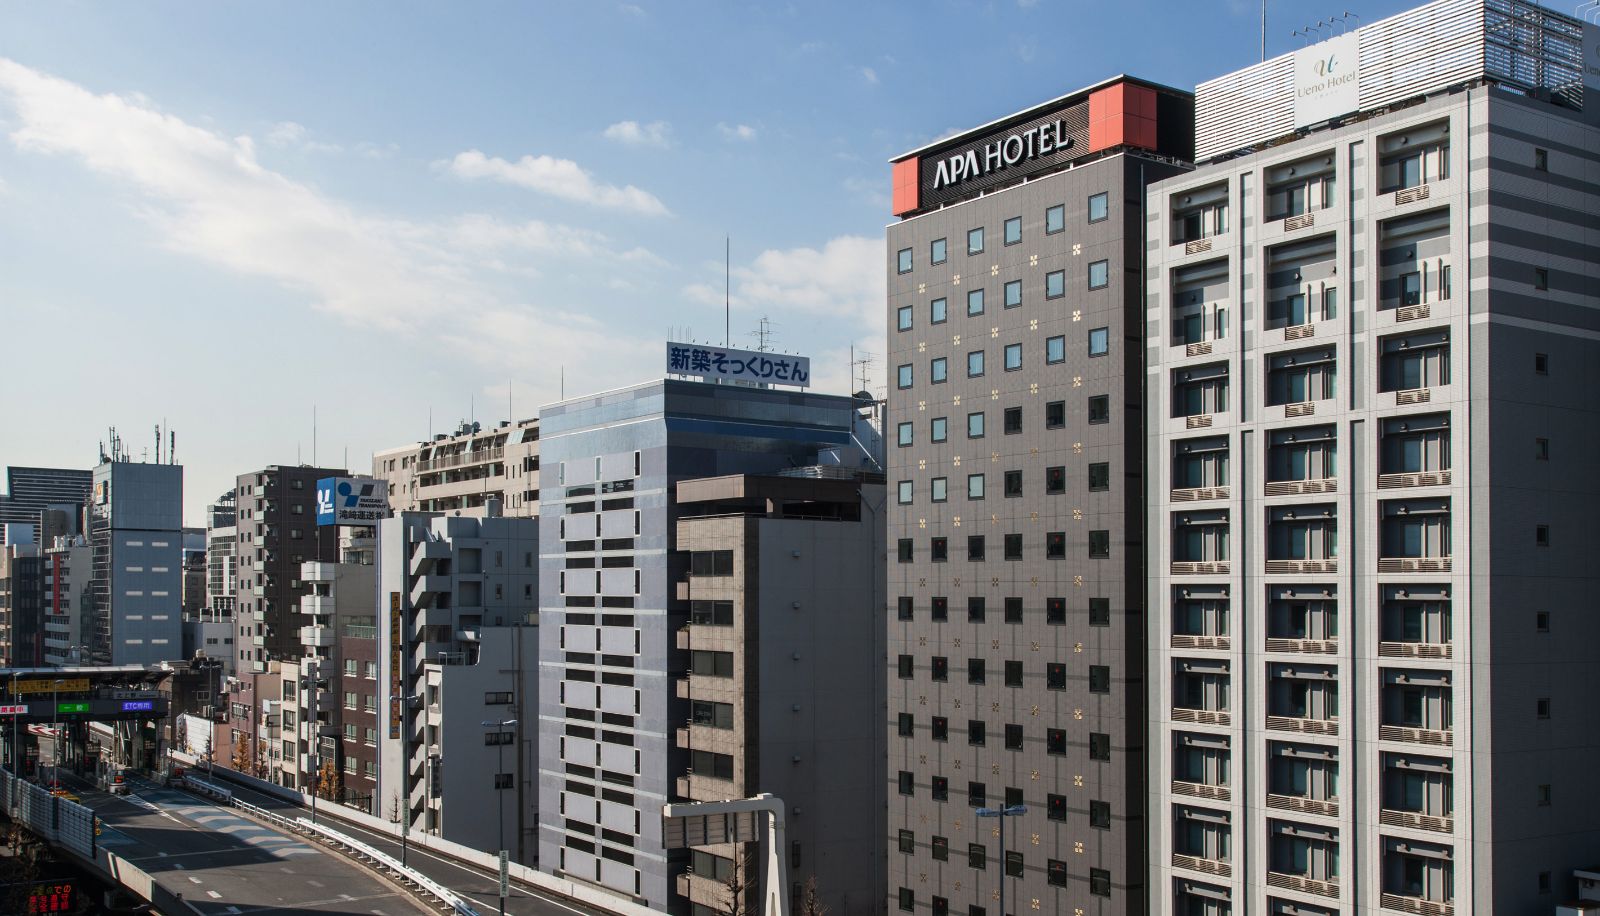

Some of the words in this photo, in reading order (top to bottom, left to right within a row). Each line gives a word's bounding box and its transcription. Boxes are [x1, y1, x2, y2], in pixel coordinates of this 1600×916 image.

[1297, 82, 1325, 98] Ueno
[1327, 70, 1356, 89] Hotel
[1584, 63, 1600, 76] Uen
[933, 149, 980, 189] APA
[984, 119, 1070, 173] HOTEL
[670, 346, 808, 382] 新築そっくりさん
